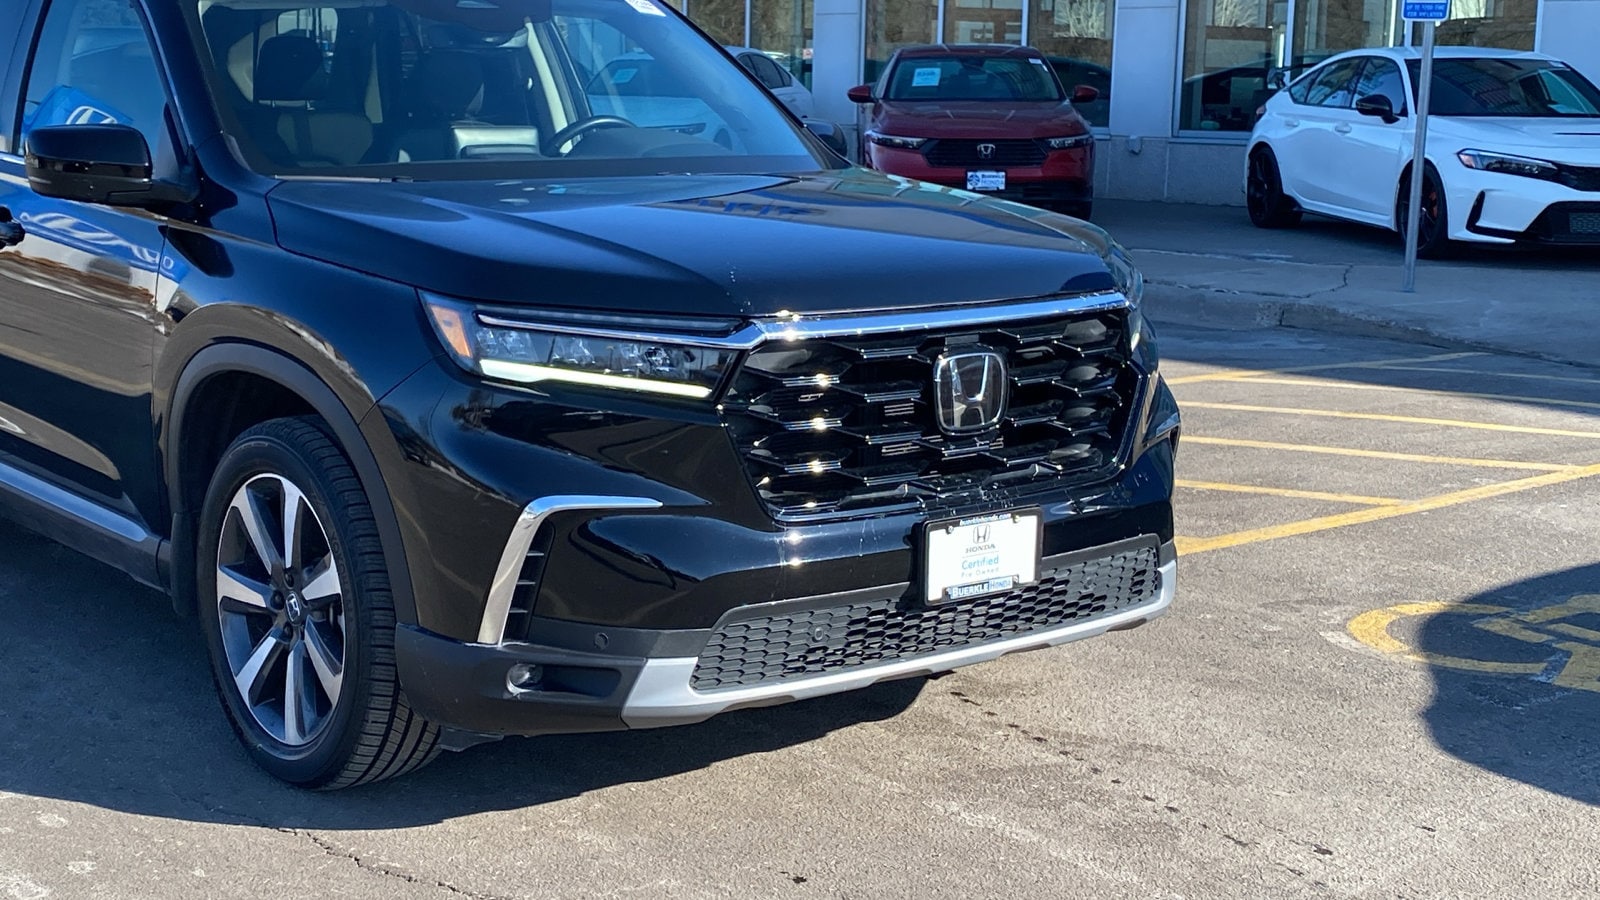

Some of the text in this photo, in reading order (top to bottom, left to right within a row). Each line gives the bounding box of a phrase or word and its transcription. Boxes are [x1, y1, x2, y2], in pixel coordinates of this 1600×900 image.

[966, 544, 996, 554] HONDA
[962, 555, 999, 570] Certified
[953, 583, 989, 597] BUERKLE
